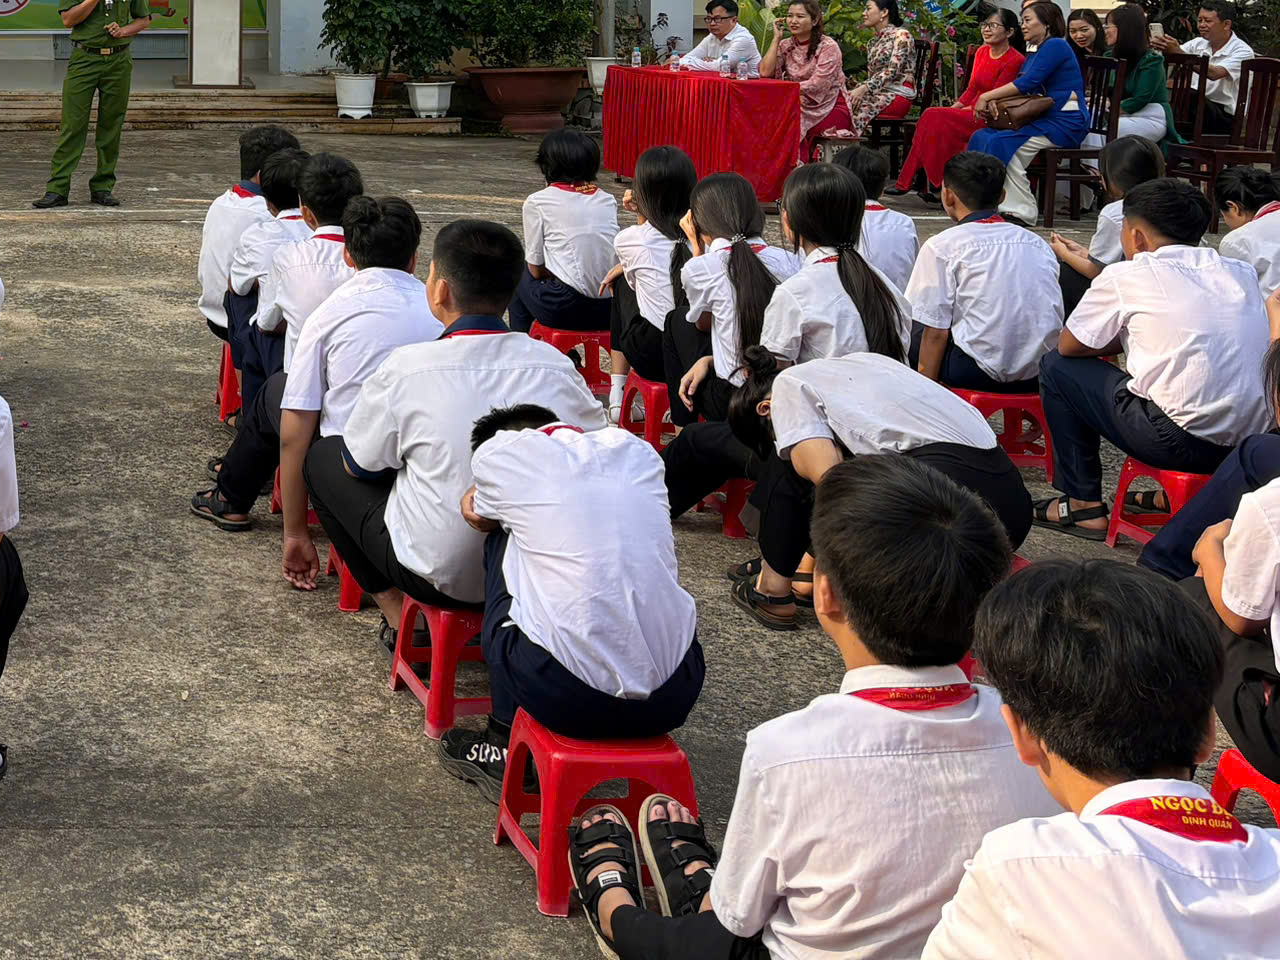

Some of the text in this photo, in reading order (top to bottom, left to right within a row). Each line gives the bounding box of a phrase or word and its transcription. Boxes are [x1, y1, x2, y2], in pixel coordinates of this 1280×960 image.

[1148, 796, 1208, 814] NGỌC
[1181, 815, 1233, 830] ĐỊNH QUÁN
